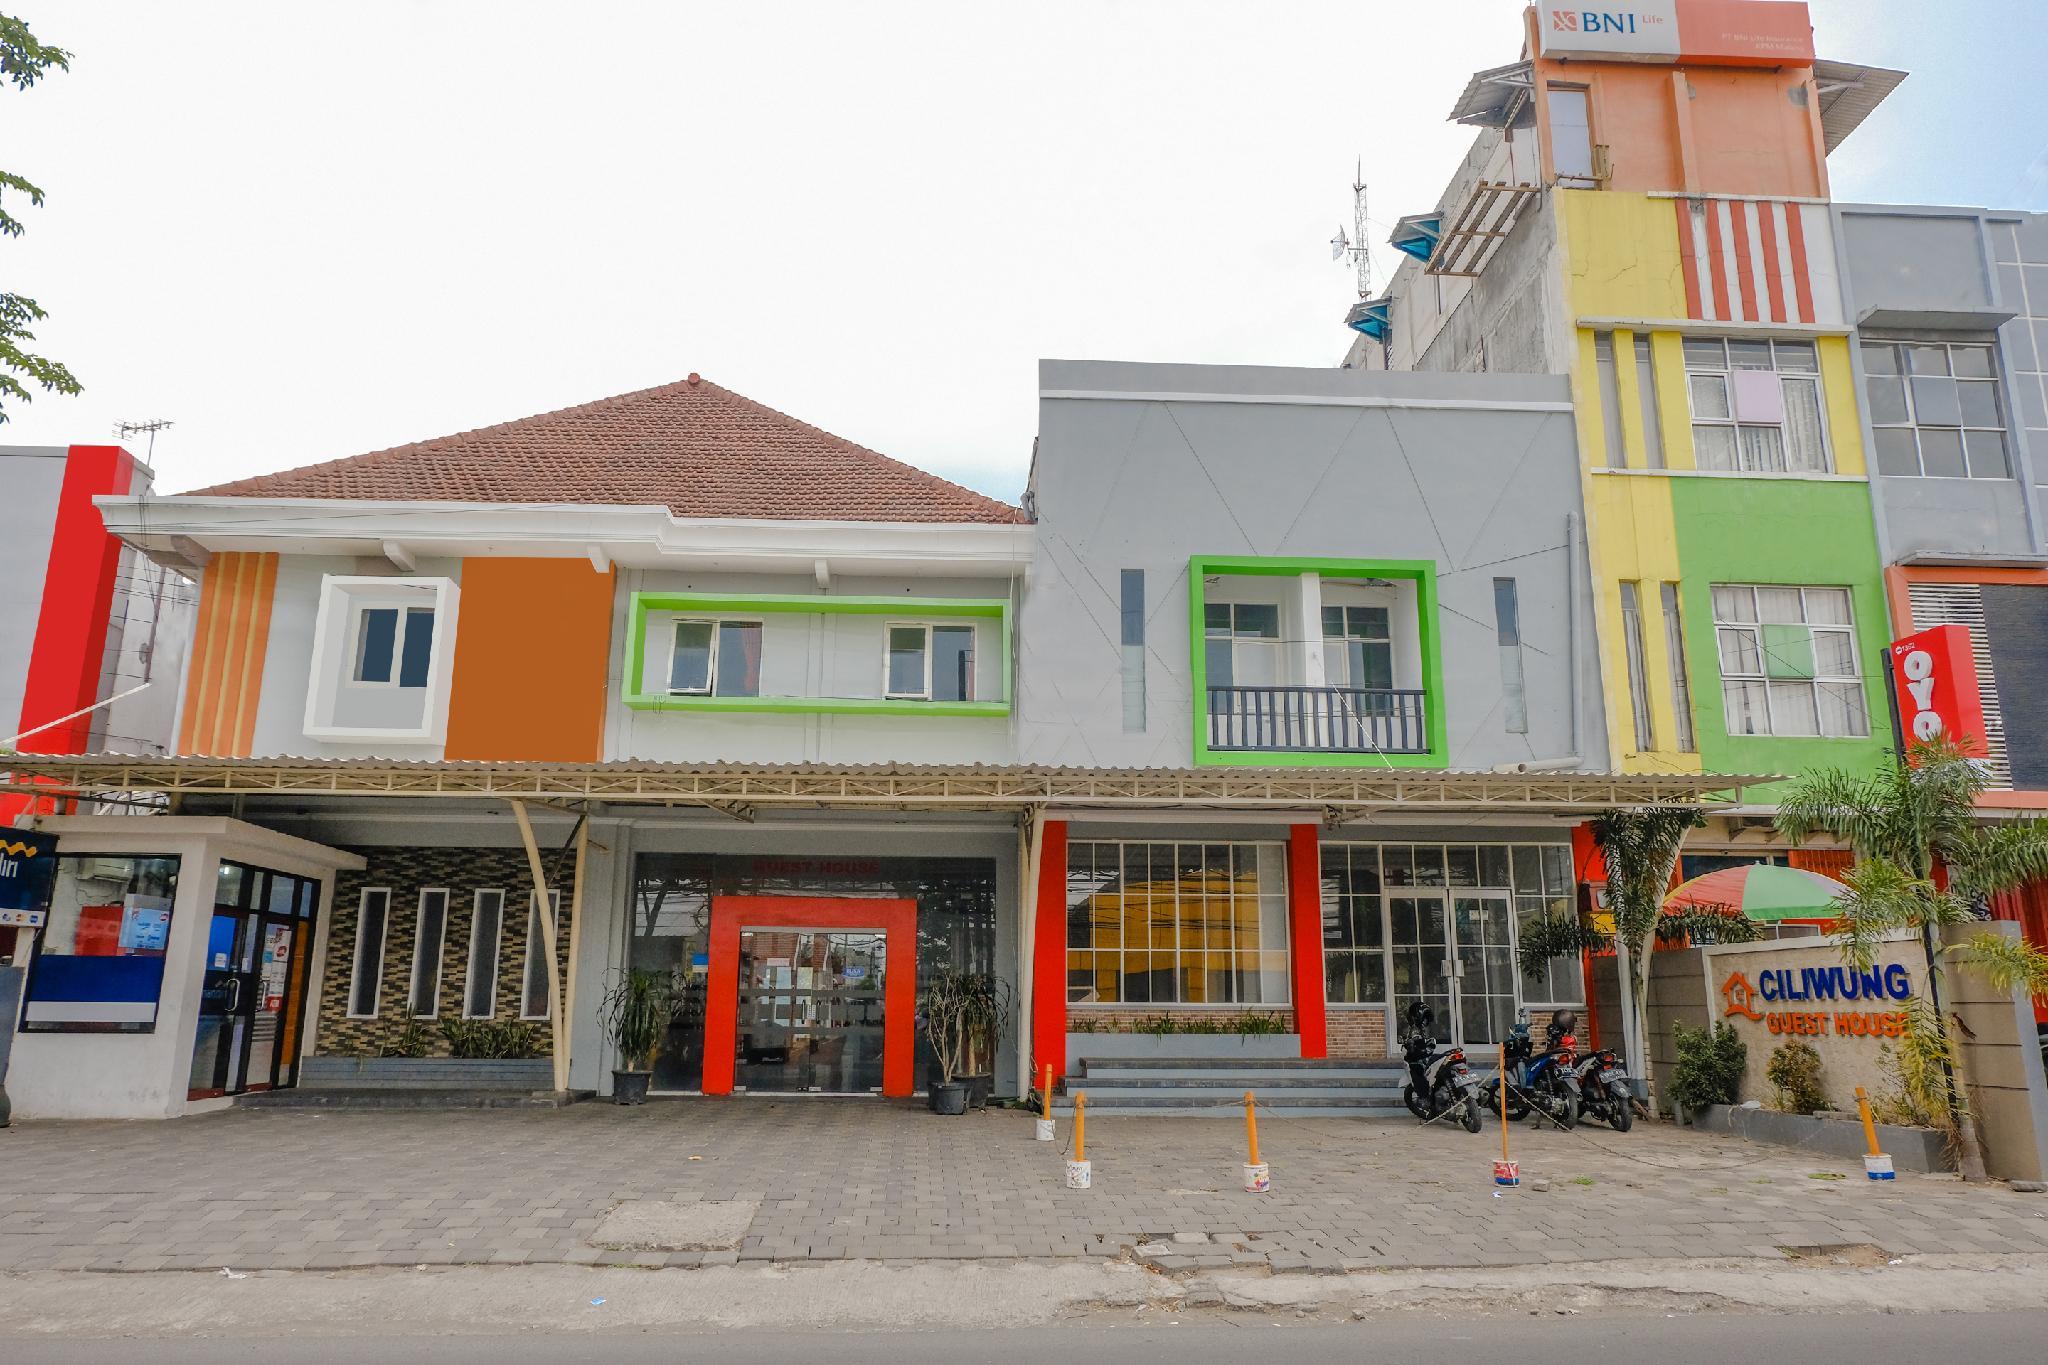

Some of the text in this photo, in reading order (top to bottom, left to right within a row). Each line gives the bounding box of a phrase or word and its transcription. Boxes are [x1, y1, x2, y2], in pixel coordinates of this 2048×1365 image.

[1582, 12, 1664, 34] BNI Life
[1904, 650, 1943, 742] OYO
[1759, 963, 1911, 1002] CILIWUNG
[1766, 1011, 1828, 1035] GUEST
